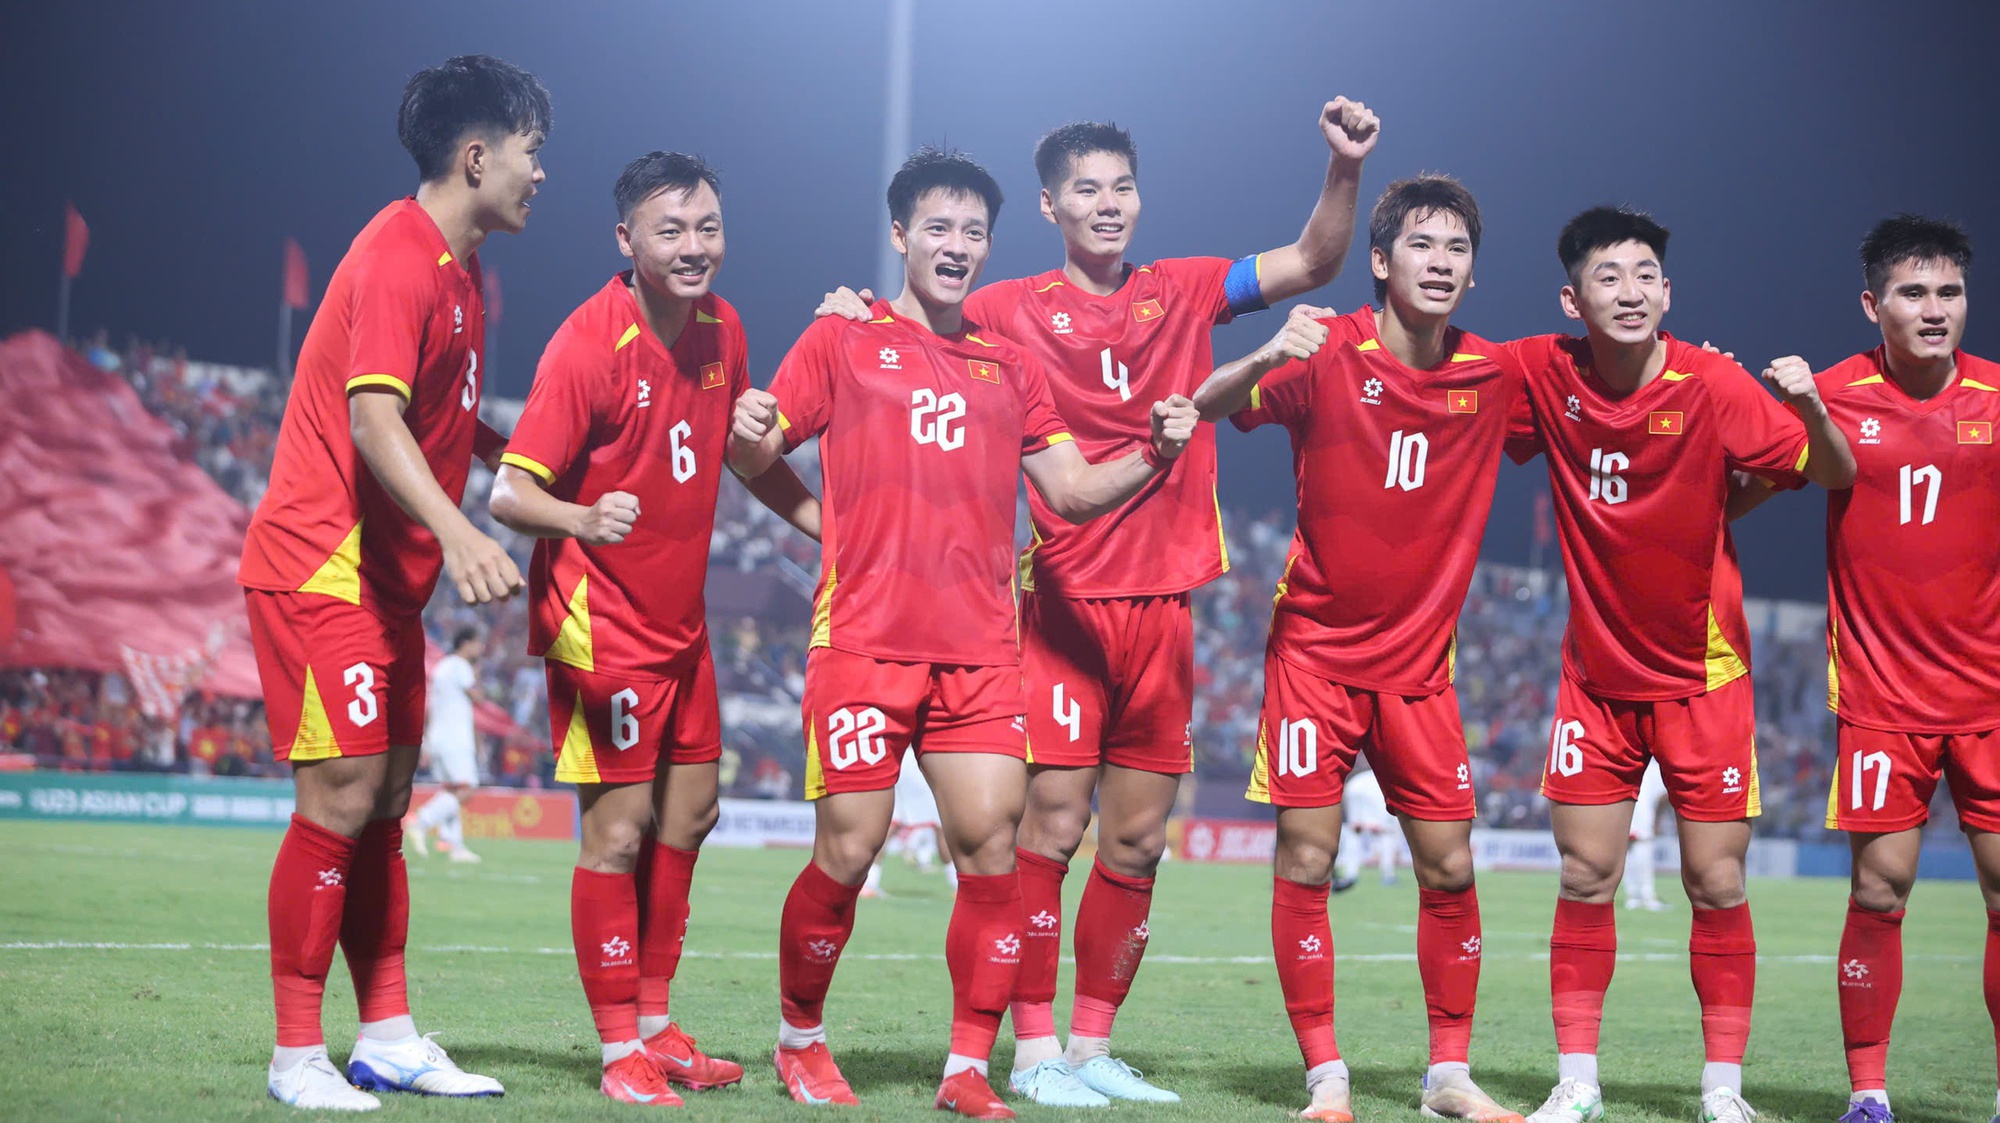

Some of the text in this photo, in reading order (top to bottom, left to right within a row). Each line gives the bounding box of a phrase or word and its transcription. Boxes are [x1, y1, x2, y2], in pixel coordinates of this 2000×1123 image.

[461, 347, 478, 412] 3
[1100, 347, 1133, 403] 4
[910, 387, 967, 452] 22
[668, 419, 697, 484] 6
[1384, 429, 1429, 492] 10
[1587, 447, 1630, 505] 16
[1899, 463, 1942, 526] 17
[343, 661, 378, 728] 3
[610, 687, 640, 751] 6
[1052, 682, 1081, 743] 4
[828, 706, 887, 771] 22
[1278, 717, 1317, 778] 10
[1549, 717, 1586, 778] 16
[1851, 749, 1892, 811] 17
